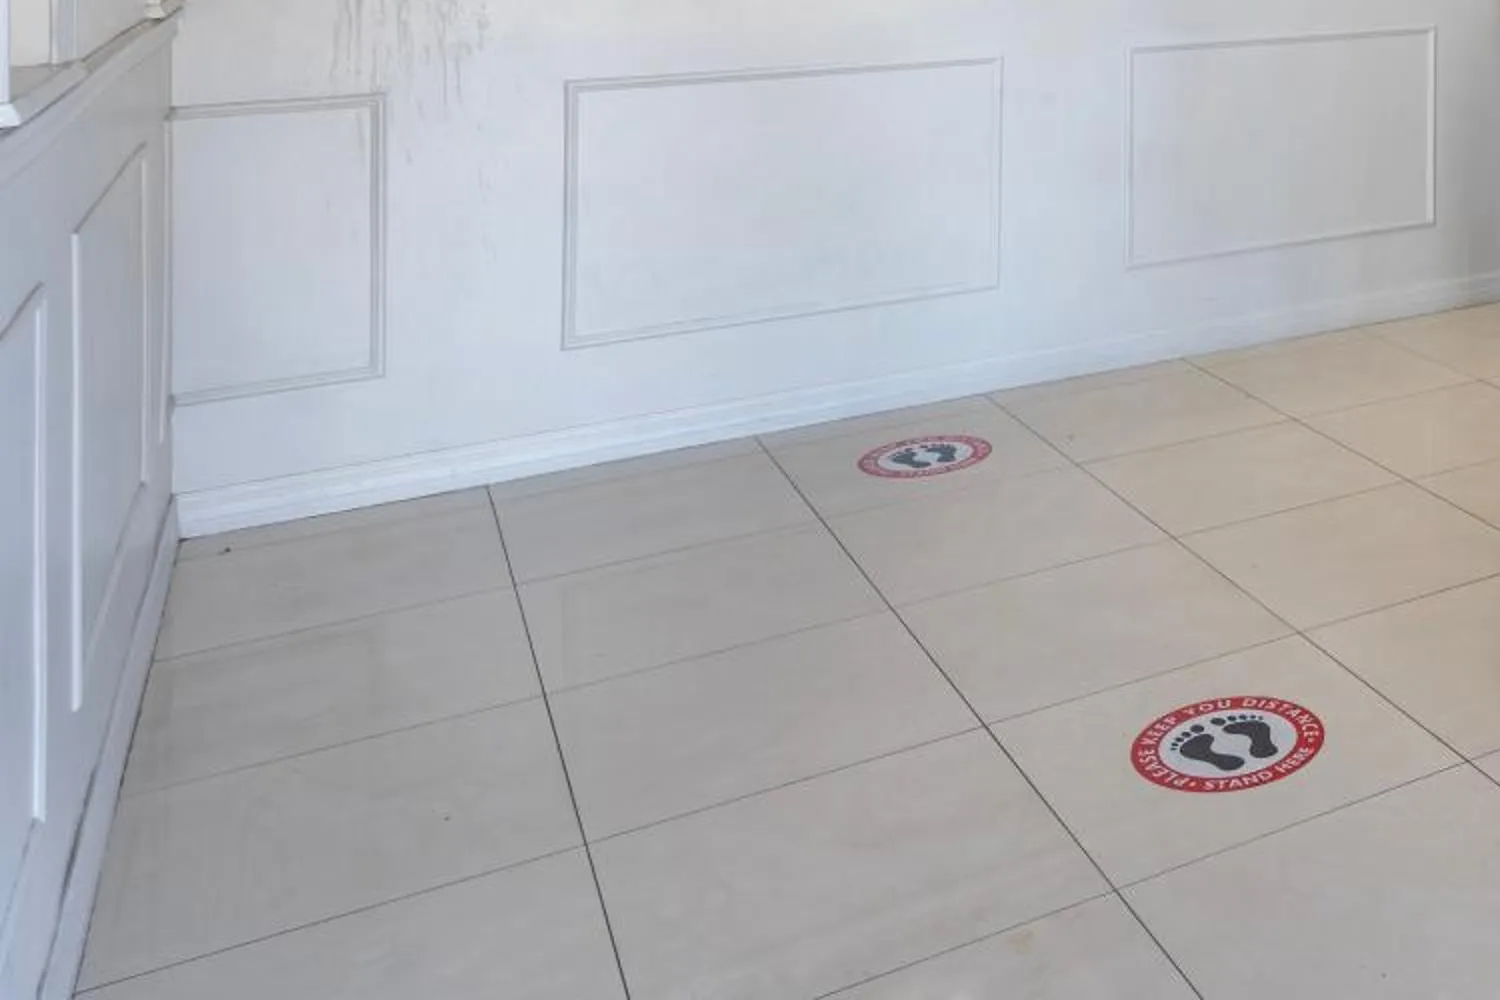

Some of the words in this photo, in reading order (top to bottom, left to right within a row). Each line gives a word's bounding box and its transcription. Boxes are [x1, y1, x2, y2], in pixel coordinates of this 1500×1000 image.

[1183, 699, 1231, 716] YOU
[1242, 698, 1319, 738] DISTANCE
[1139, 715, 1178, 746] KEEP
[1137, 749, 1190, 788] PLEASE
[1203, 768, 1272, 791] STAND
[1274, 746, 1315, 774] HERE
